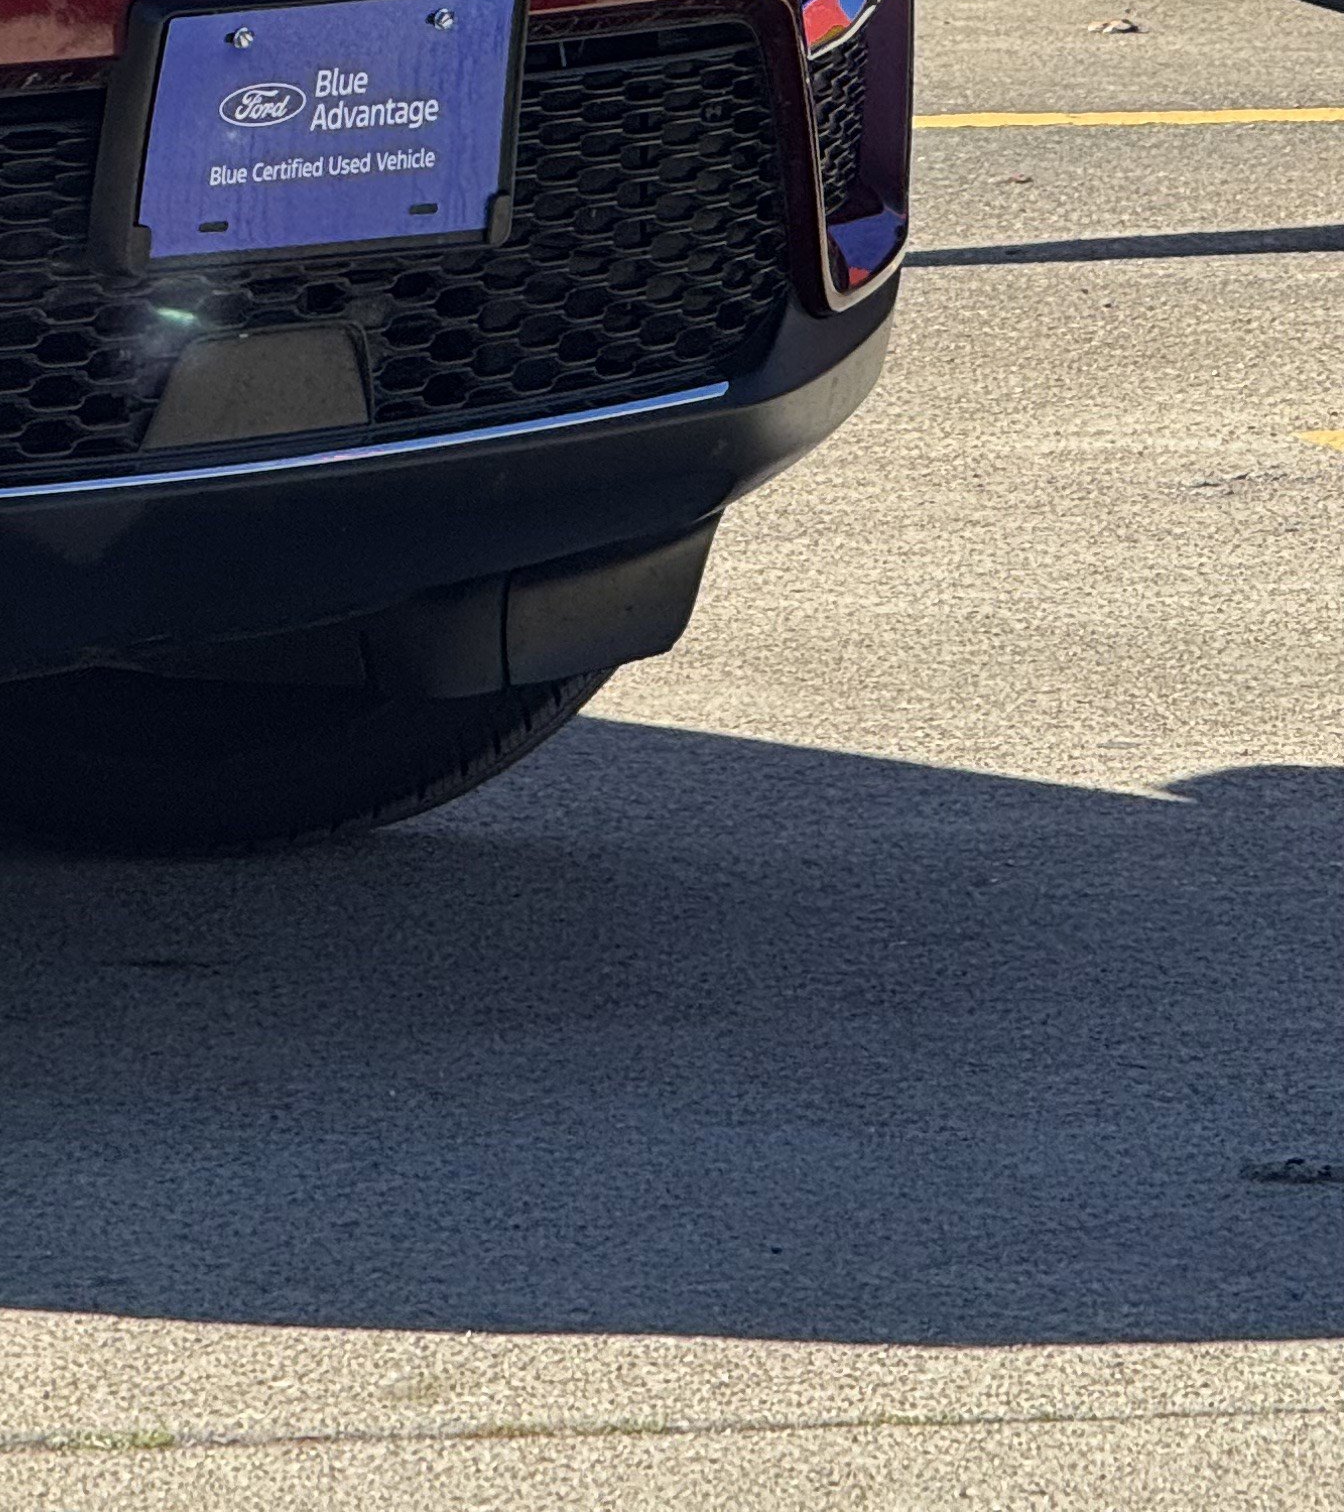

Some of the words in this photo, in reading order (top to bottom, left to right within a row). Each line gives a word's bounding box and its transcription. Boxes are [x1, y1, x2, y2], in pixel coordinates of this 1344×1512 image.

[315, 68, 369, 98] Blue
[234, 88, 291, 121] Ford
[310, 97, 439, 132] Advantage
[210, 165, 248, 187] Blue
[252, 157, 324, 183] Certified
[328, 152, 372, 177] Used
[376, 147, 436, 172] Vehicle
